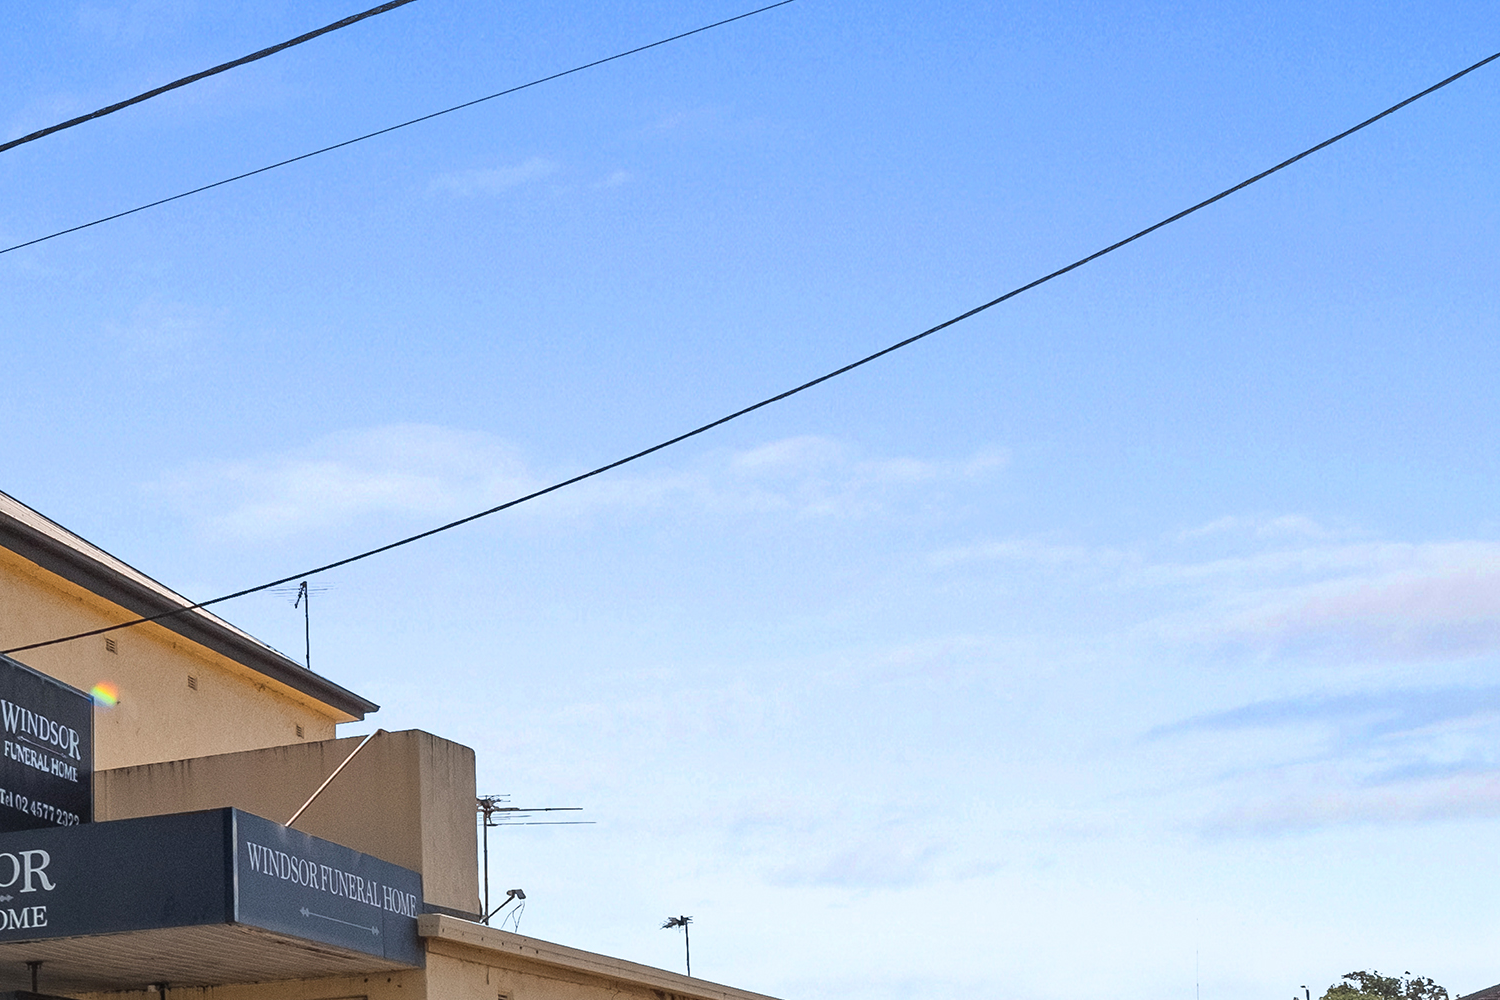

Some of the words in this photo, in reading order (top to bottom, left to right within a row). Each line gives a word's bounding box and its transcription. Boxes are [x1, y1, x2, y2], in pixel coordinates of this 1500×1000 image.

[0, 699, 82, 761] WINDSOR
[4, 740, 50, 773] FUNERAL
[51, 758, 79, 783] HOME
[15, 794, 29, 815] 02
[30, 801, 55, 822] 4577
[246, 841, 319, 890] WINDSOR
[320, 864, 382, 908] FUNERAL
[382, 885, 418, 919] HOME
